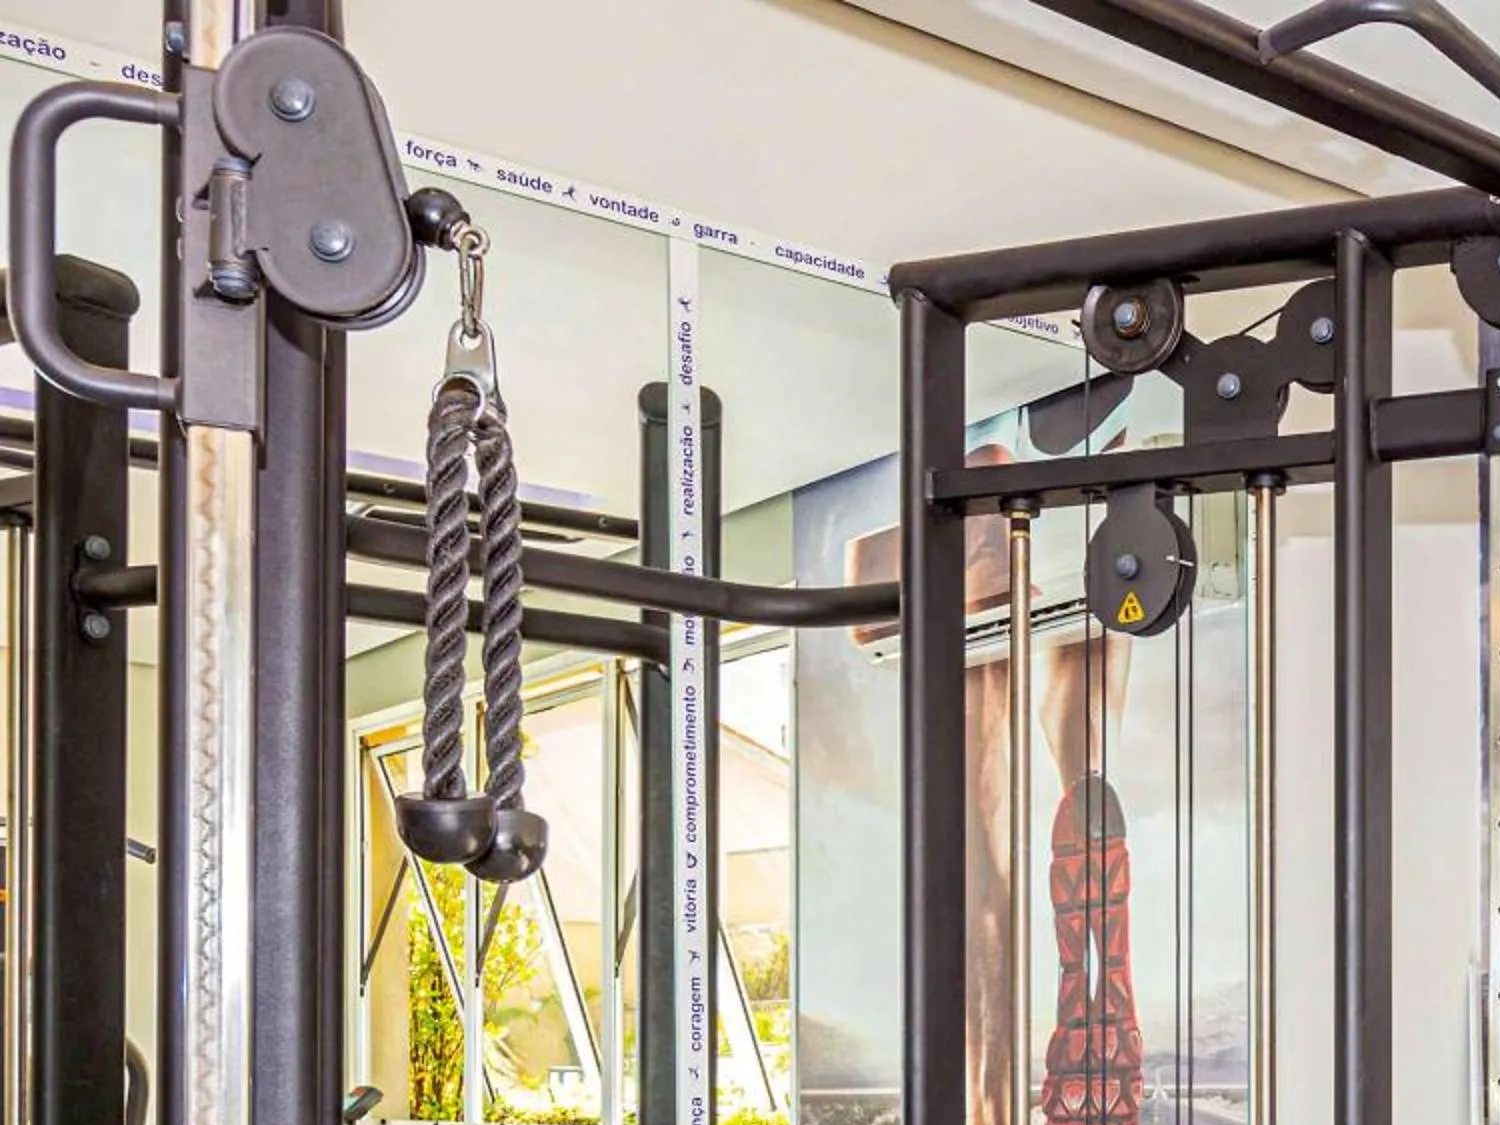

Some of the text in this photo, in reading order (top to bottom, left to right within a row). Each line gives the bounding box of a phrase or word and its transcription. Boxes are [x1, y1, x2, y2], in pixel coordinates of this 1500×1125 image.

[405, 140, 457, 168] força
[496, 168, 553, 193] saúde
[589, 192, 659, 223] vontade
[693, 222, 739, 245] garra
[775, 244, 866, 280] capacidade
[678, 321, 692, 386] desafio
[683, 685, 699, 843] comprometimento
[690, 976, 705, 1053] coragem
